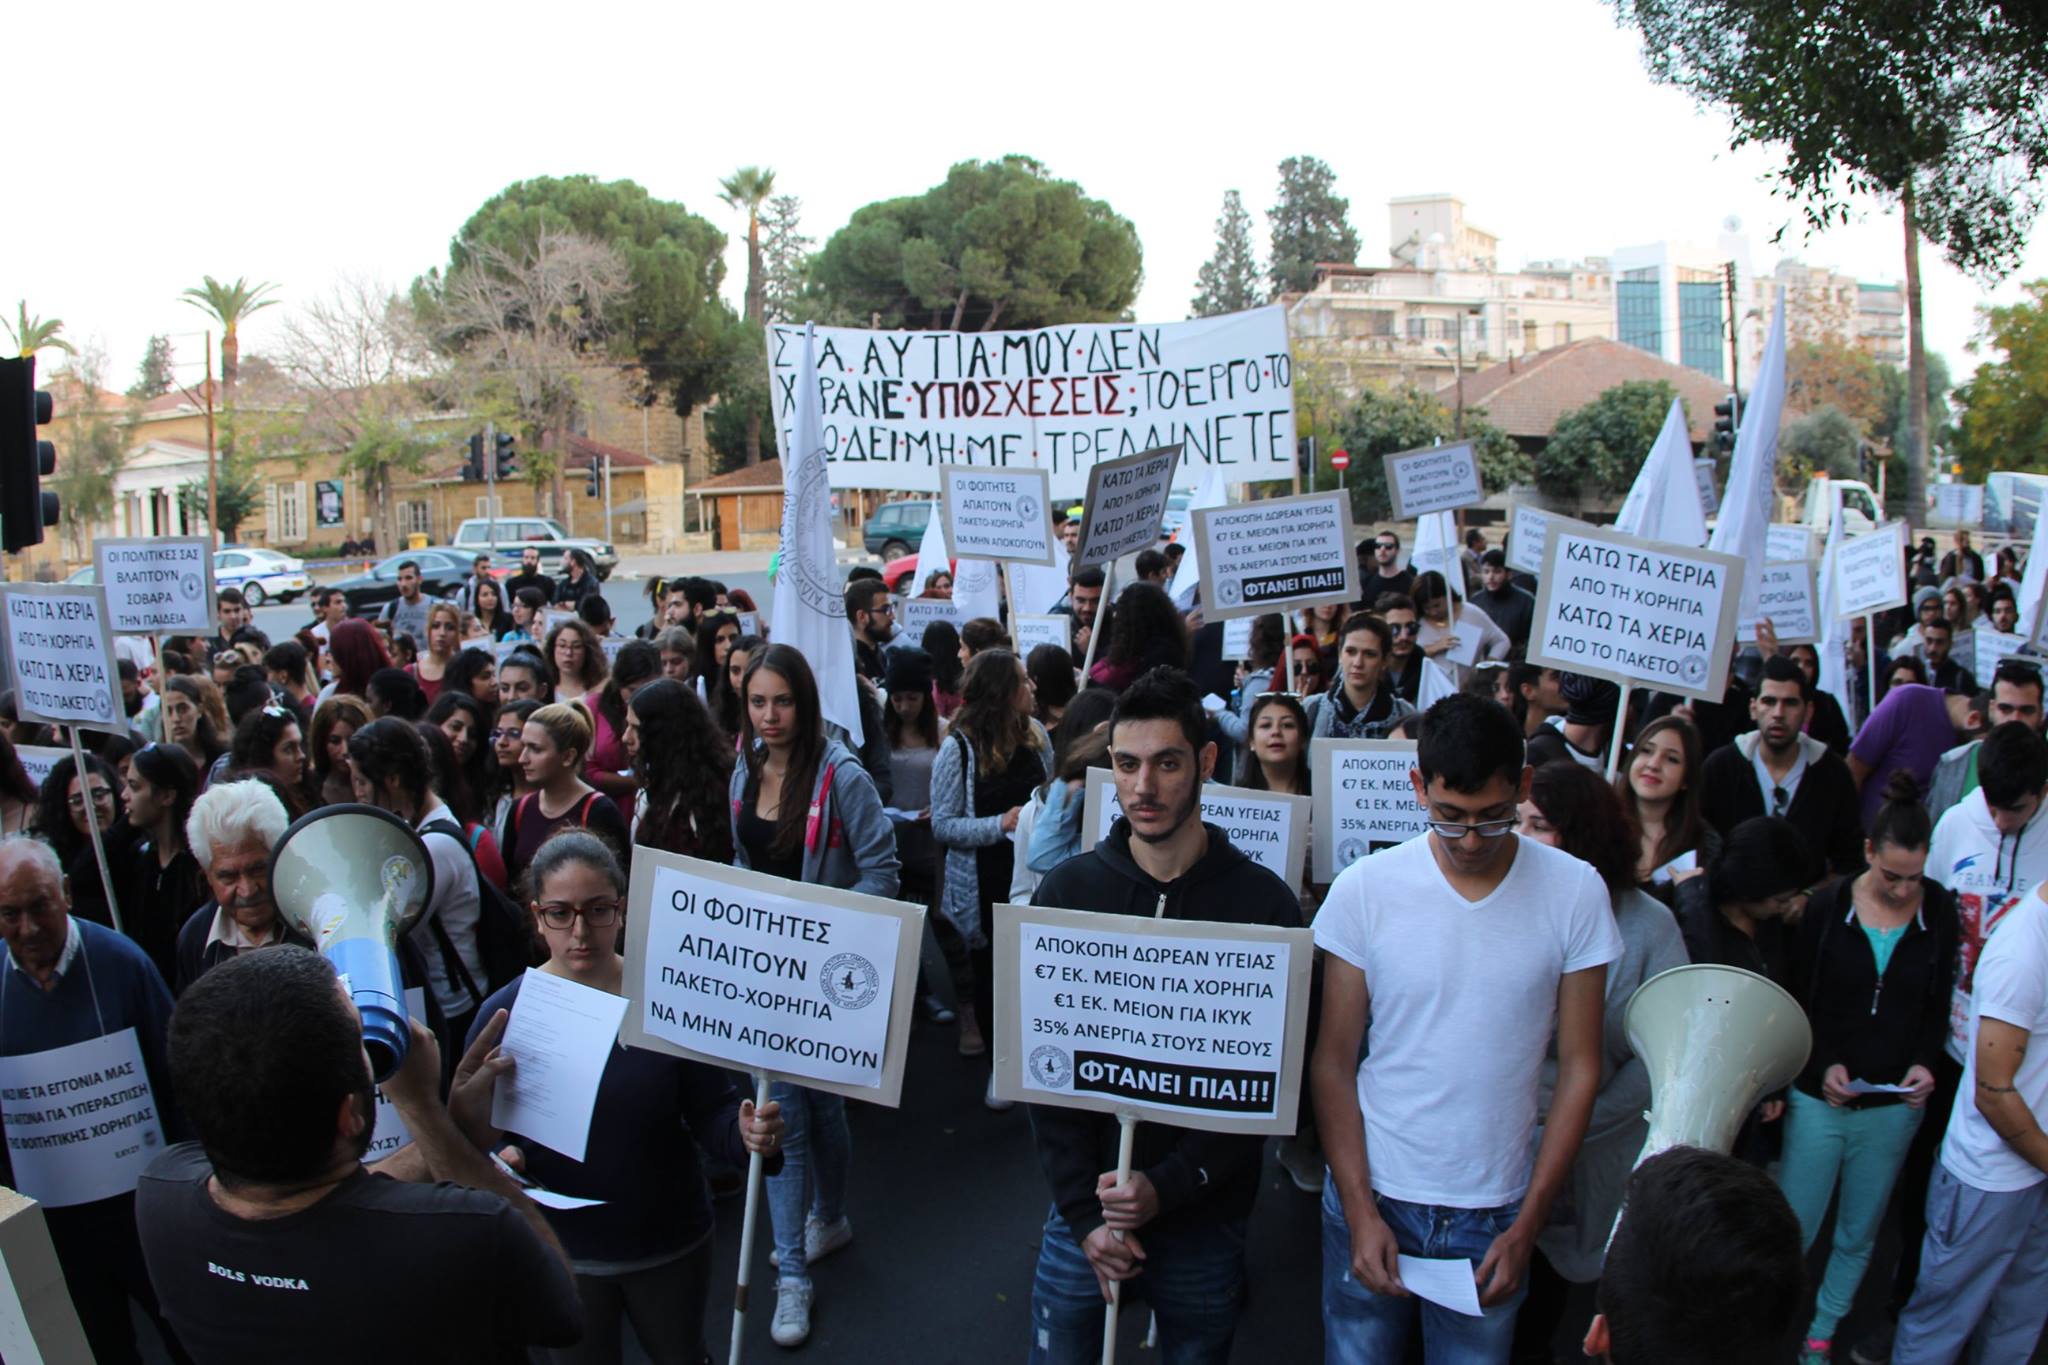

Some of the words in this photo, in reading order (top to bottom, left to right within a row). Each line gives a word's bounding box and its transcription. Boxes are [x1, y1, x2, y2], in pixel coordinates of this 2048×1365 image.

[1087, 328, 1160, 373] ΔΕΝ
[778, 374, 905, 419] ΧΡΑΝΕ
[956, 480, 966, 490] ΟΙ
[968, 481, 1016, 493] ΦΟΙΤΗΤΕΣ
[1102, 470, 1132, 488] ΚΑΤΩ
[963, 500, 1012, 512] ΑΠΑΙΤΟΥΝ
[1103, 497, 1124, 510] ΑΠΟ
[1214, 514, 1263, 526] ΑΠΟΚΟΠΗ
[1264, 509, 1302, 520] ΔΩΡΕΑΝ
[1305, 504, 1334, 516] ΥΓΕΙΑΣ
[1094, 518, 1122, 536] ΚΑΤΩ
[1216, 532, 1227, 542] €7
[1230, 531, 1244, 540] ΕΚ.
[1247, 528, 1279, 539] ΜΕΙΟΝ
[1281, 525, 1294, 534] ΓΙΑ
[1297, 520, 1336, 532] ΧΟΡΗΓΙΑ
[970, 536, 990, 544] ΜΗΝ
[992, 538, 1045, 549] ΑΠΟΚΟΠΟΥΝ
[1086, 544, 1108, 558] ΑΠΟ
[1228, 547, 1239, 556] €1
[1242, 545, 1256, 554] ΕΚ.
[1258, 541, 1289, 552] ΜΕΙΟΝ
[1292, 539, 1305, 548] ΓΙΑ
[1308, 536, 1328, 546] ΙΚΥΚ
[108, 552, 119, 562] ΟΙ
[122, 550, 177, 562] ΠΟΛΙΤΙΚΕΣ
[180, 549, 198, 560] ΣΑΣ
[1218, 564, 1237, 573] 35%
[1240, 558, 1278, 570] ΑΝΕΡΓΙΑ
[1280, 555, 1307, 566] ΣΤΟΥΣ
[1310, 551, 1340, 562] ΝΕΟΥΣ
[1566, 541, 1620, 568] ΚΑΤΩ
[1627, 553, 1650, 576] ΤΑ
[1657, 560, 1717, 589] ΧΕΡΙΑ
[117, 570, 179, 583] ΒΛΑΠΤΟΥΝ
[1244, 578, 1299, 596] ΦΤΑΝΕΙ
[1302, 572, 1342, 589] ΠΙΑ!!!
[127, 592, 173, 605] ΣΟΒΑΡΑ
[1570, 576, 1605, 595] ΑΠΟ
[1611, 583, 1630, 601] ΤΗ
[1634, 588, 1703, 616] ΧΟΡΗΓΙΑ
[12, 600, 37, 618] ΚΑΤΩ
[38, 602, 54, 619] ΤΑ
[57, 602, 95, 620] ΧΕΡΙΑ
[119, 615, 140, 626] ΤΗΝ
[143, 614, 186, 624] ΠΑΙΔΕΙΑ
[1558, 602, 1612, 630] ΚΑΤΩ
[1619, 615, 1642, 637] ΤΑ
[1648, 622, 1706, 651] ΧΕΡΙΑ
[36, 634, 48, 648] ΤΗ
[49, 635, 96, 650] ΧΟΡΗΓΙΑ
[1550, 635, 1586, 654] ΑΠΟ
[1591, 642, 1612, 659] ΤΟ
[1616, 648, 1679, 674] ΠΑΚΕΤΟ
[18, 658, 45, 679] ΚΑΤΩ
[46, 663, 64, 681] ΤΑ
[66, 664, 105, 684] ΧΕΡΙΑ
[40, 693, 52, 707] ΤΟ
[54, 695, 96, 711] ΠΑΚΕΤΟ
[1342, 759, 1405, 770] ΑΠΟΚΟΠΗ
[1343, 779, 1357, 790] €7
[1360, 780, 1378, 790] ΕΚ.
[1382, 780, 1415, 791] ΜΕΙΟ
[1200, 803, 1234, 818] ΡΕΑΝ
[1239, 807, 1280, 821] ΥΓΕΙΑΣ
[1356, 799, 1370, 809] €1
[1374, 799, 1392, 810] ΕΚ.
[1396, 801, 1428, 811] ΜΕΙΟ
[1227, 827, 1279, 842] ΧΟΡΗΓΙΑ
[1341, 819, 1366, 830] 35%
[1369, 820, 1420, 832] ΑΝΕΡΓΙΑ
[672, 890, 695, 914] ΟΙ
[704, 898, 831, 944] ΦΟΙΤΗΤΕΣ
[680, 934, 807, 982] ΑΠΑΙΤΟΥΝ
[1035, 937, 1127, 959] ΑΠΟΚΟΠΗ
[1133, 947, 1209, 966] ΔΩΡΕΑΝ
[1214, 952, 1276, 970] ΥΓΕΙΑΣ
[1035, 964, 1056, 980] €7
[1062, 967, 1088, 983] ΕΚ.
[1094, 970, 1155, 990] ΜΕΙΟΝ
[1162, 977, 1187, 993] ΓΙΑ
[1193, 980, 1273, 999] ΧΟΡΗΓΙΑ
[662, 967, 832, 1021] ΠΑΚΕΤΟ-ΧΟΡΗΓΙΑ
[1054, 993, 1075, 1008] €1
[1081, 995, 1107, 1011] ΕΚ.
[1114, 998, 1174, 1020] ΜΕΙΟΝ
[1180, 1006, 1206, 1023] ΓΙΑ
[1212, 1009, 1252, 1026] ΙΚΥΚ
[652, 1001, 676, 1025] ΝΑ
[683, 1011, 731, 1040] ΜΗΝ
[738, 1028, 878, 1069] ΑΠΟΚΟΠΟΥΝ
[1033, 1018, 1069, 1036] 35%
[1074, 1023, 1146, 1046] ΑΝΕΡΓΙΑ
[1151, 1034, 1206, 1053] ΣΤΟΥΣ
[1212, 1039, 1272, 1057] ΝΕΟΥΣ
[48, 1072, 103, 1095] ΕΓΓΟΝΙΑ
[104, 1062, 134, 1081] ΜΑΣ
[1079, 1060, 1180, 1095] ΦΤΑΝΕΙ
[1189, 1077, 1270, 1102] ΠΙΑ!!!
[46, 1107, 67, 1122] ΓΙΑ
[68, 1083, 148, 1117] ΥΠΕΡΑΣΠΙΣΗ
[21, 1128, 88, 1149] ΦΟΙΤΗΤΙΚΗΣ
[90, 1108, 153, 1138] ΧΟΡΗΓΙΑΣ
[208, 1262, 245, 1282] BOLS
[250, 1274, 309, 1290] VODKA
